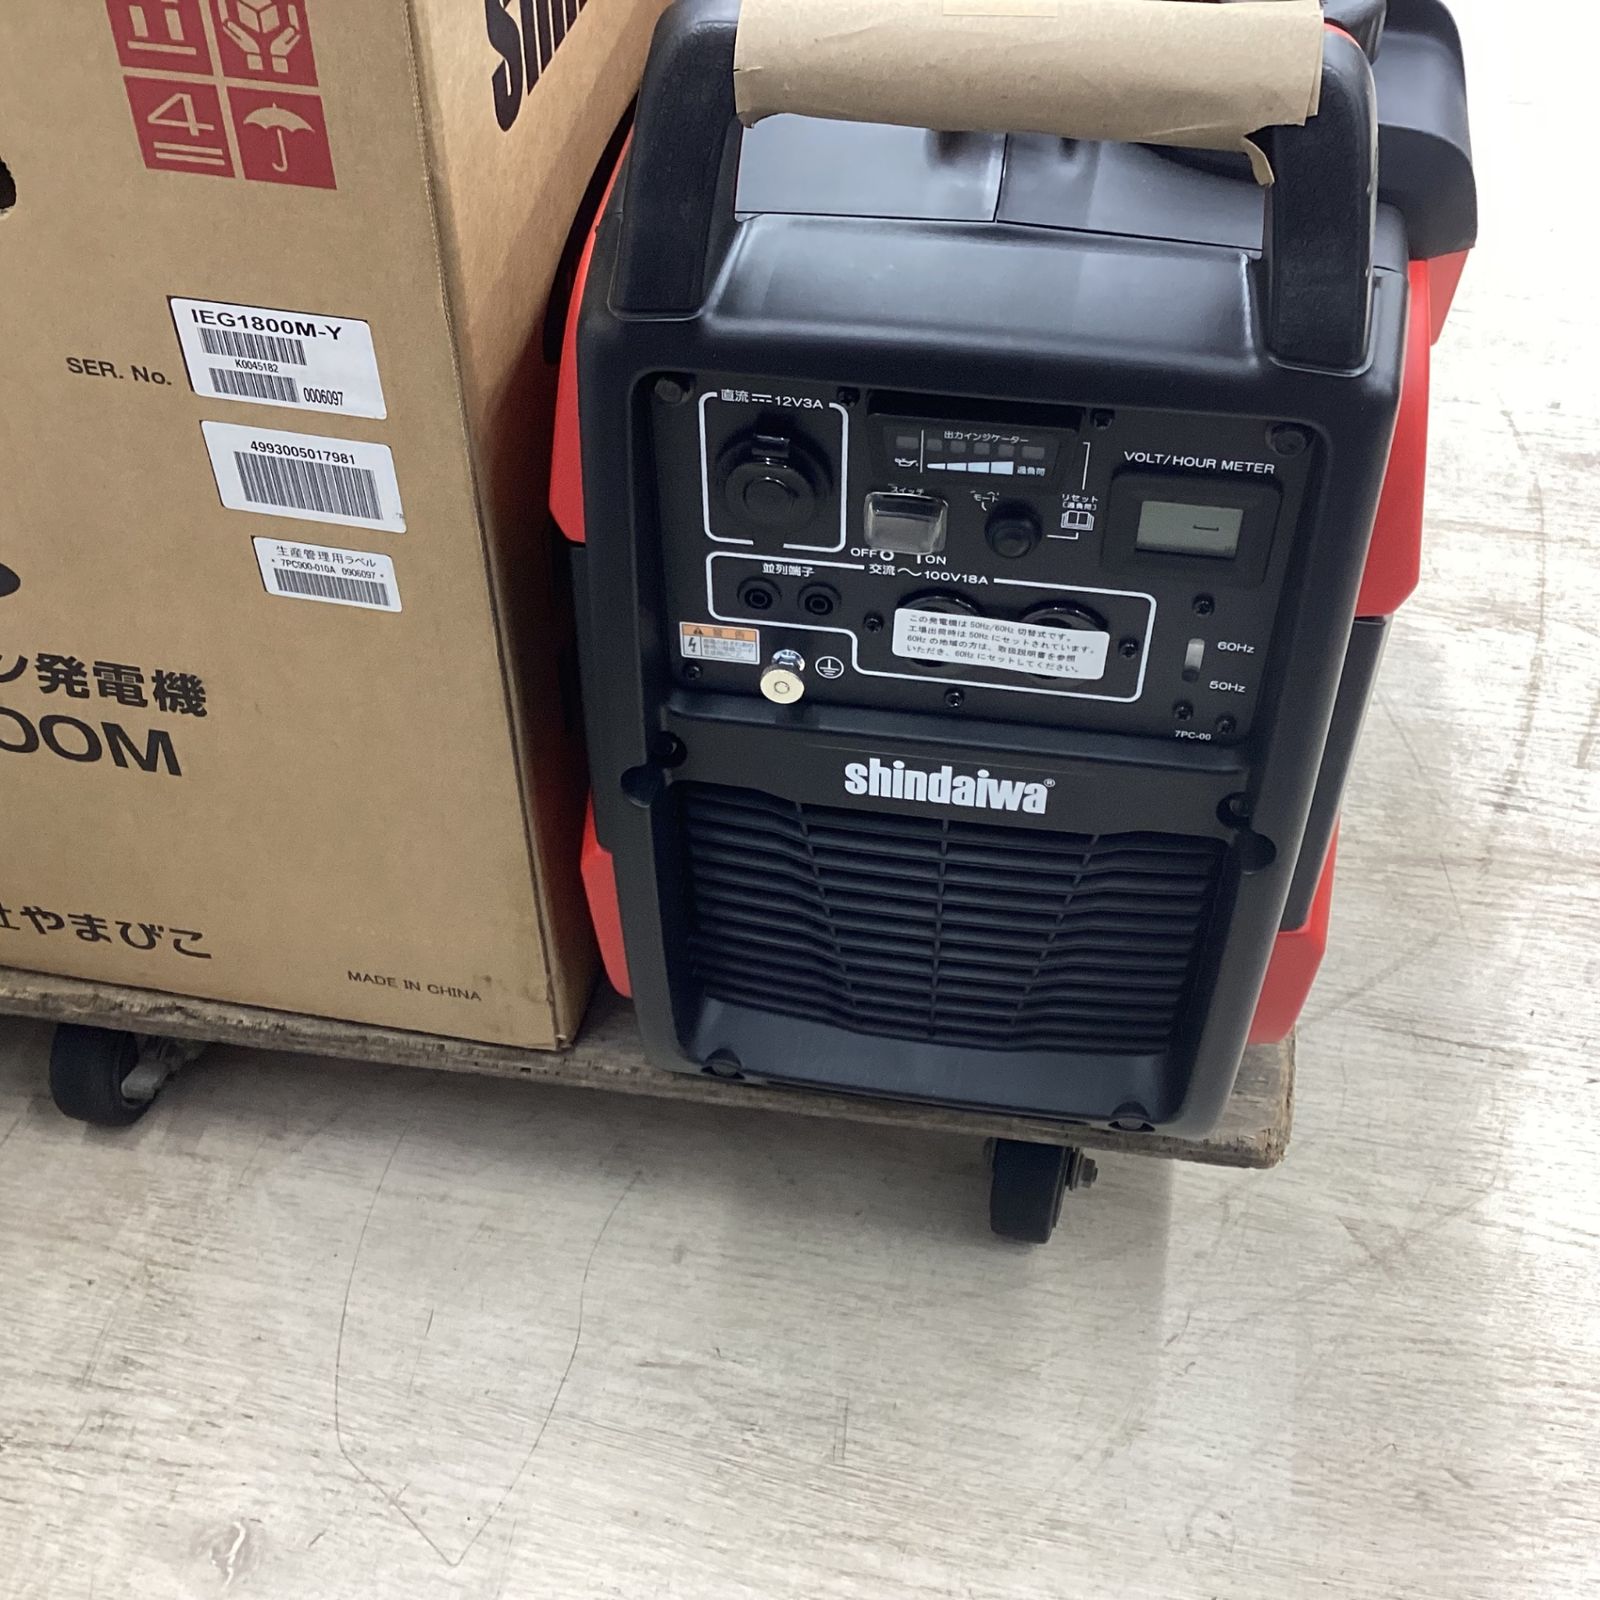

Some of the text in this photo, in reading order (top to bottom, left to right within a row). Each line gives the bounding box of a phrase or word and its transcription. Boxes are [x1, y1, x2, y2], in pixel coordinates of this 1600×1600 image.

[190, 308, 343, 341] IEG1800M-Y
[65, 357, 172, 386] SER. No.
[234, 358, 279, 374] K0045182
[303, 387, 344, 406] 0006097
[775, 395, 824, 410] 12V3A
[250, 440, 356, 465] 4993005017981
[1123, 451, 1276, 475] VOLT/HOUR METER
[1062, 493, 1099, 504] リセット
[276, 545, 377, 568] 生産管理用ラベル
[850, 547, 878, 559] OFF
[925, 555, 947, 566] ON
[924, 570, 989, 585] 100V18A
[1217, 641, 1256, 654] 60Hz
[1208, 680, 1247, 693] 50Hz
[347, 970, 483, 1002] MADE IN CHINA
